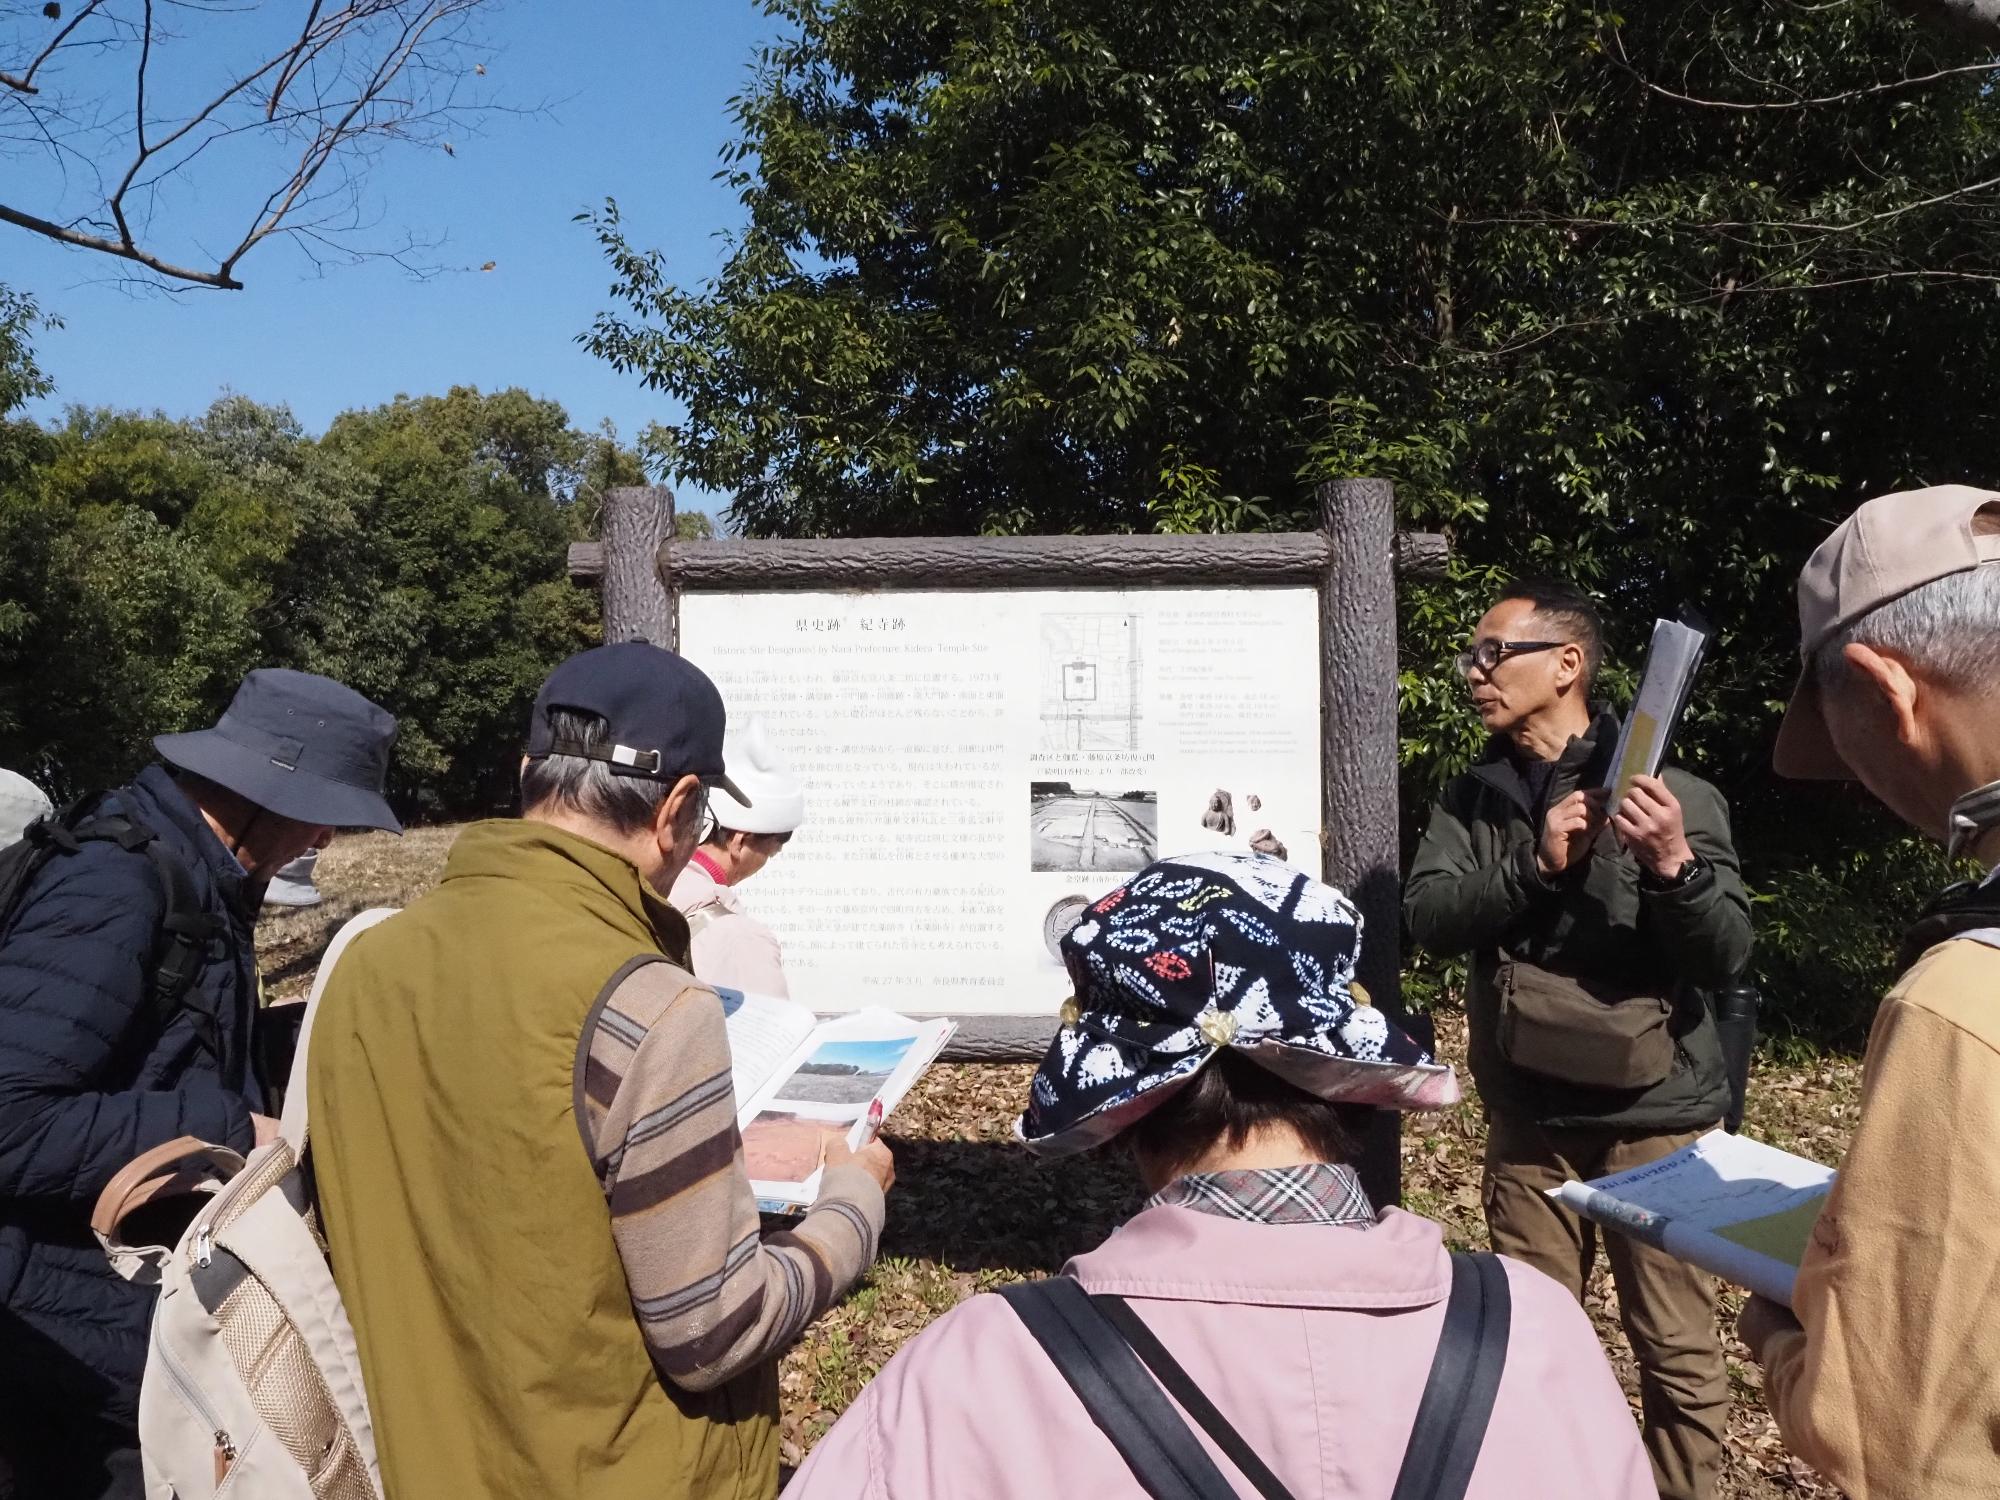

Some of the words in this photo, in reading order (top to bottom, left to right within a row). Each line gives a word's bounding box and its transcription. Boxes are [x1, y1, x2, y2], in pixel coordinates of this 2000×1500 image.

[794, 618, 842, 632] 県史跡
[859, 617, 907, 632] 紀寺跡
